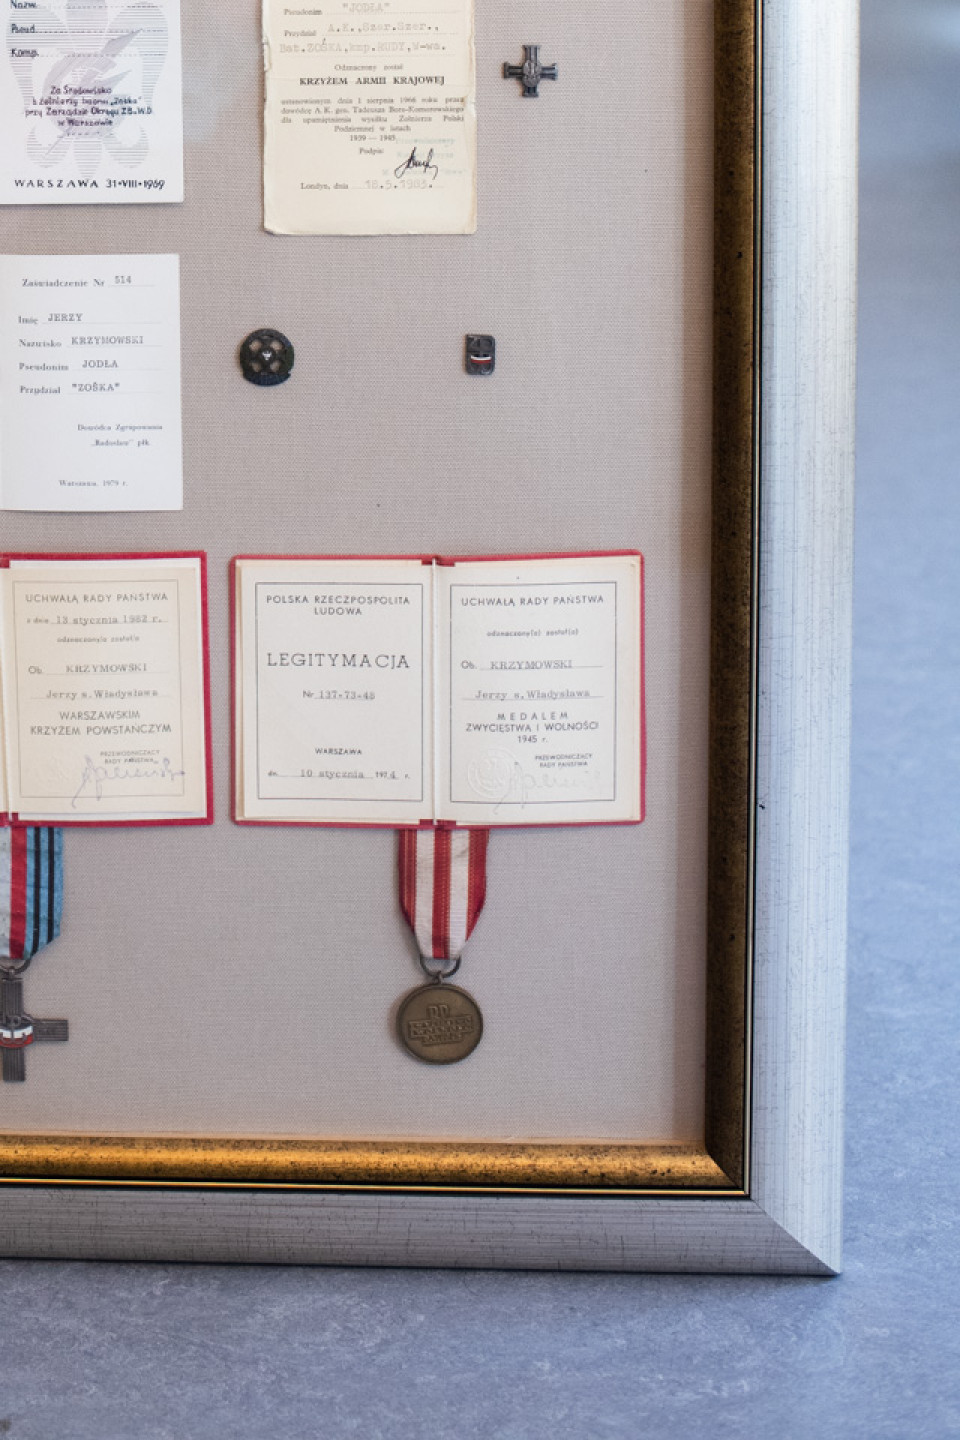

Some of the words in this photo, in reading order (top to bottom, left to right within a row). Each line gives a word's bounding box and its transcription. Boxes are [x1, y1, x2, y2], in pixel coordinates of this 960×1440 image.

[299, 75, 348, 86] KRZYŻEM
[355, 76, 387, 85] ARMII
[392, 75, 445, 86] KRAJOWEJ
[14, 178, 99, 189] WARSZAWA
[21, 278, 88, 289] Zaświadczenie
[93, 278, 105, 288] Nr
[113, 275, 132, 285] 514
[47, 313, 84, 324] JERZY
[71, 335, 144, 346] KRZYMOWSKI
[18, 362, 70, 373] Pseudonim
[81, 359, 119, 370] JODŁA
[20, 384, 61, 396] Przydział
[25, 594, 79, 605] UCHWAŁĄ
[83, 593, 112, 603] RADY
[116, 592, 168, 602] PAŃSTWA
[266, 594, 309, 604] POLSKA
[314, 595, 411, 605] RZECZPOSPOLITA
[460, 597, 516, 608] UCHWAŁĄ
[519, 596, 549, 606] RADY
[553, 594, 604, 605] PAŃSTWA
[314, 606, 363, 616] LUDOWA
[73, 615, 118, 626] stycznia
[266, 652, 411, 670] LEGITYMACJA
[490, 660, 573, 670] KRZYMOWSKI
[65, 663, 148, 673] KRZYMOWSKI
[46, 689, 76, 701] Jerzy
[302, 689, 315, 699] Nr
[475, 689, 508, 702] Jerzy
[59, 710, 141, 721] WARSZAWSKIM
[497, 712, 568, 721] MEDALEM
[30, 724, 81, 736] KRZYŻEM
[86, 723, 172, 735] POWSTAŃCZYM
[465, 722, 532, 733] ZWYCIĘSTWA
[545, 720, 600, 731] WOLNOŚCI
[517, 734, 538, 744] 1945
[314, 747, 363, 756] WARSZAWA
[300, 768, 313, 778] 10
[318, 768, 365, 780] stycznia
